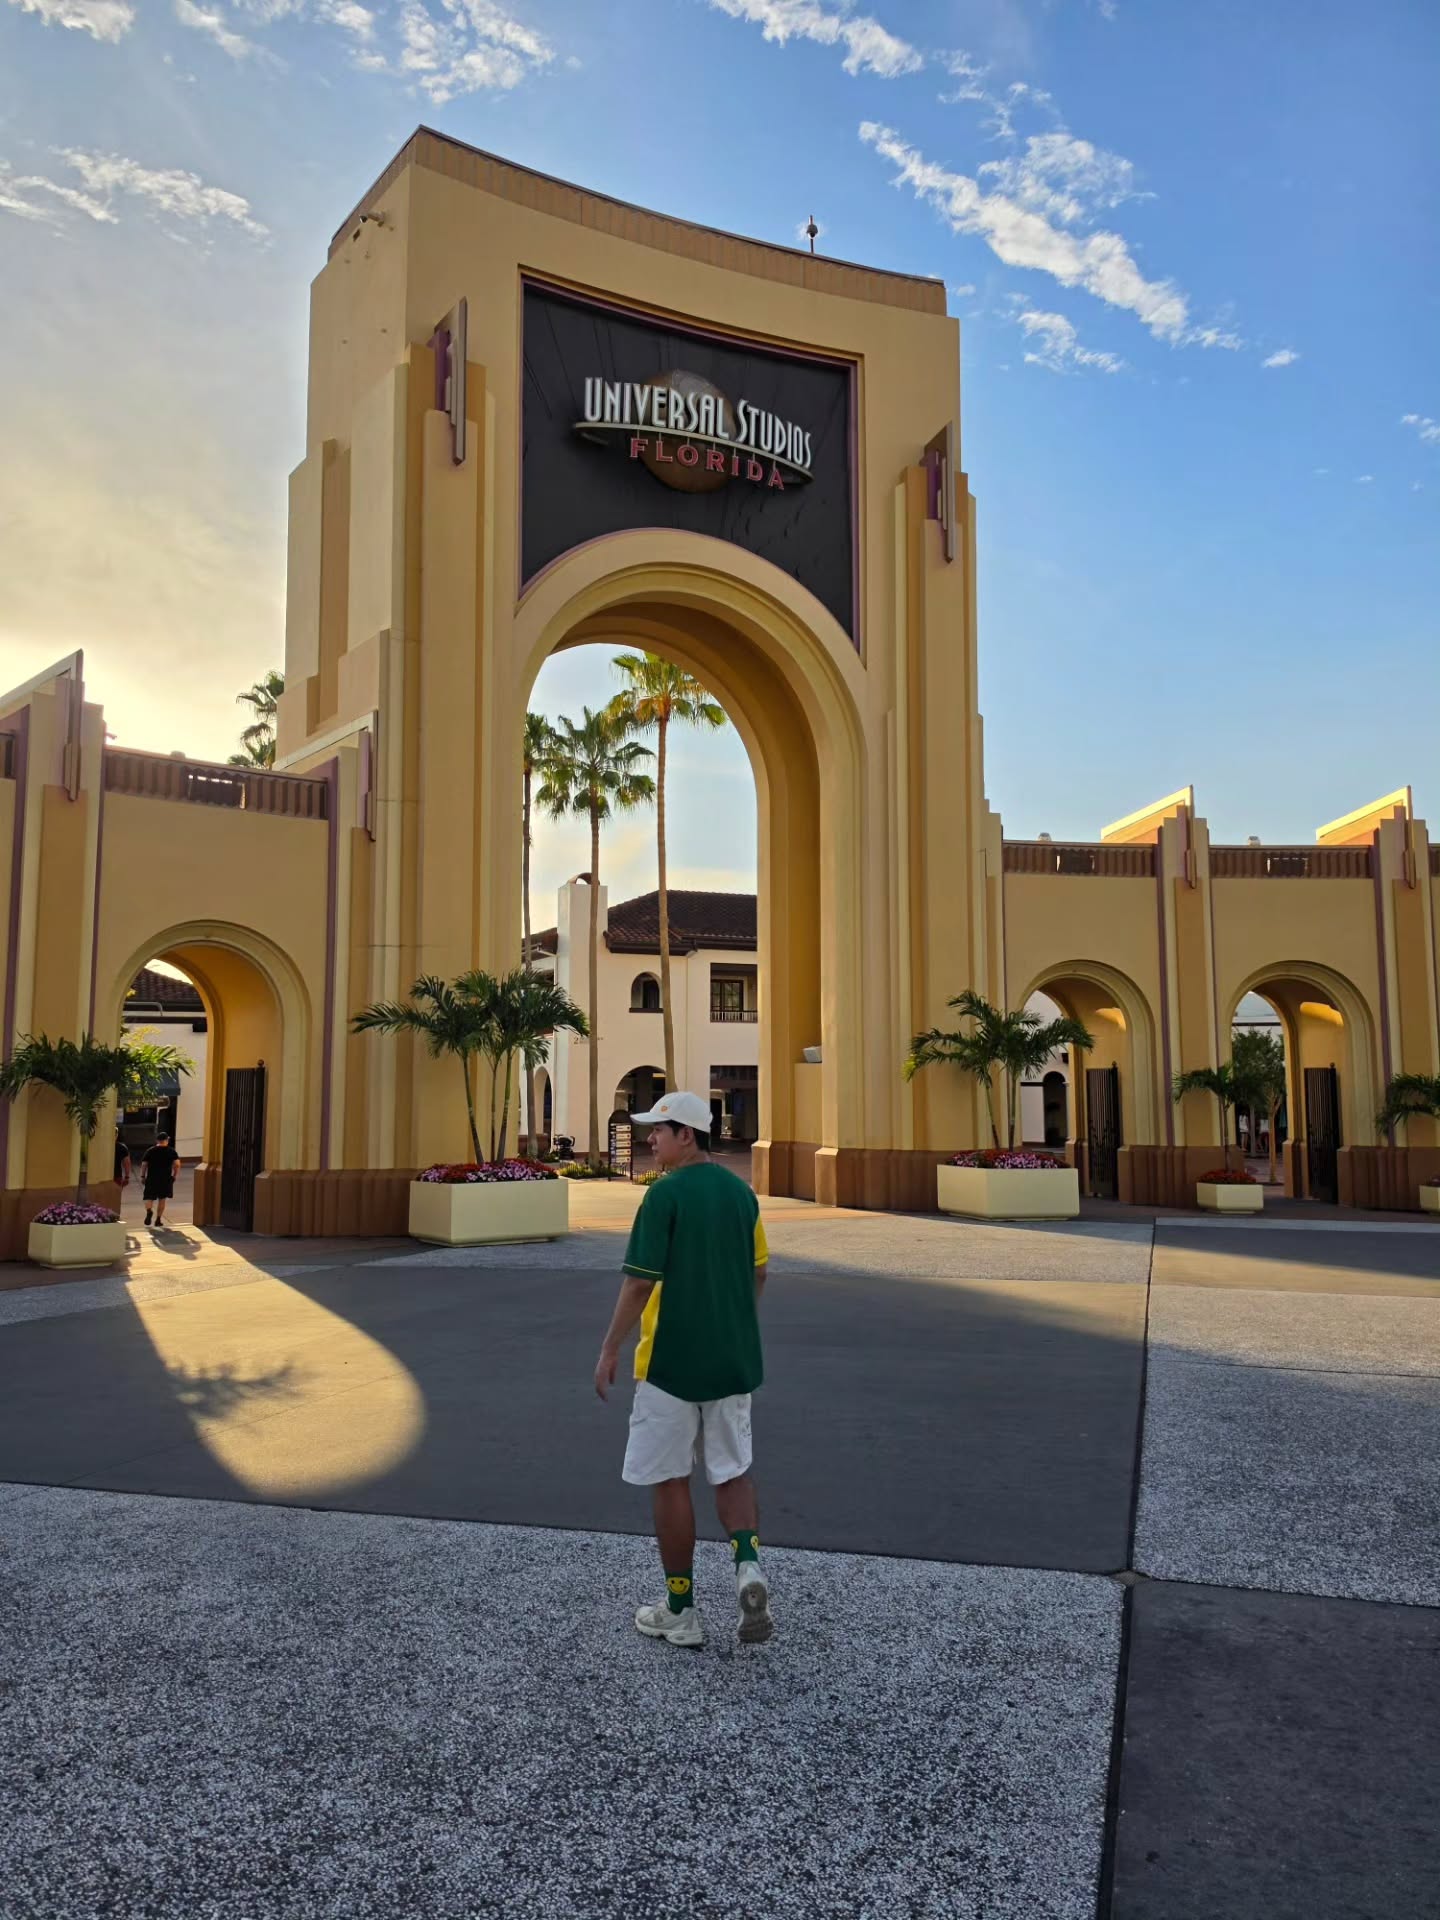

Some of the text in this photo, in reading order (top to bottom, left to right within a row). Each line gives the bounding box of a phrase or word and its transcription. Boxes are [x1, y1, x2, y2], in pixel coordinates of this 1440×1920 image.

[584, 377, 811, 469] UNIVERSAL STUDIOS
[630, 438, 785, 490] FLORIDA
